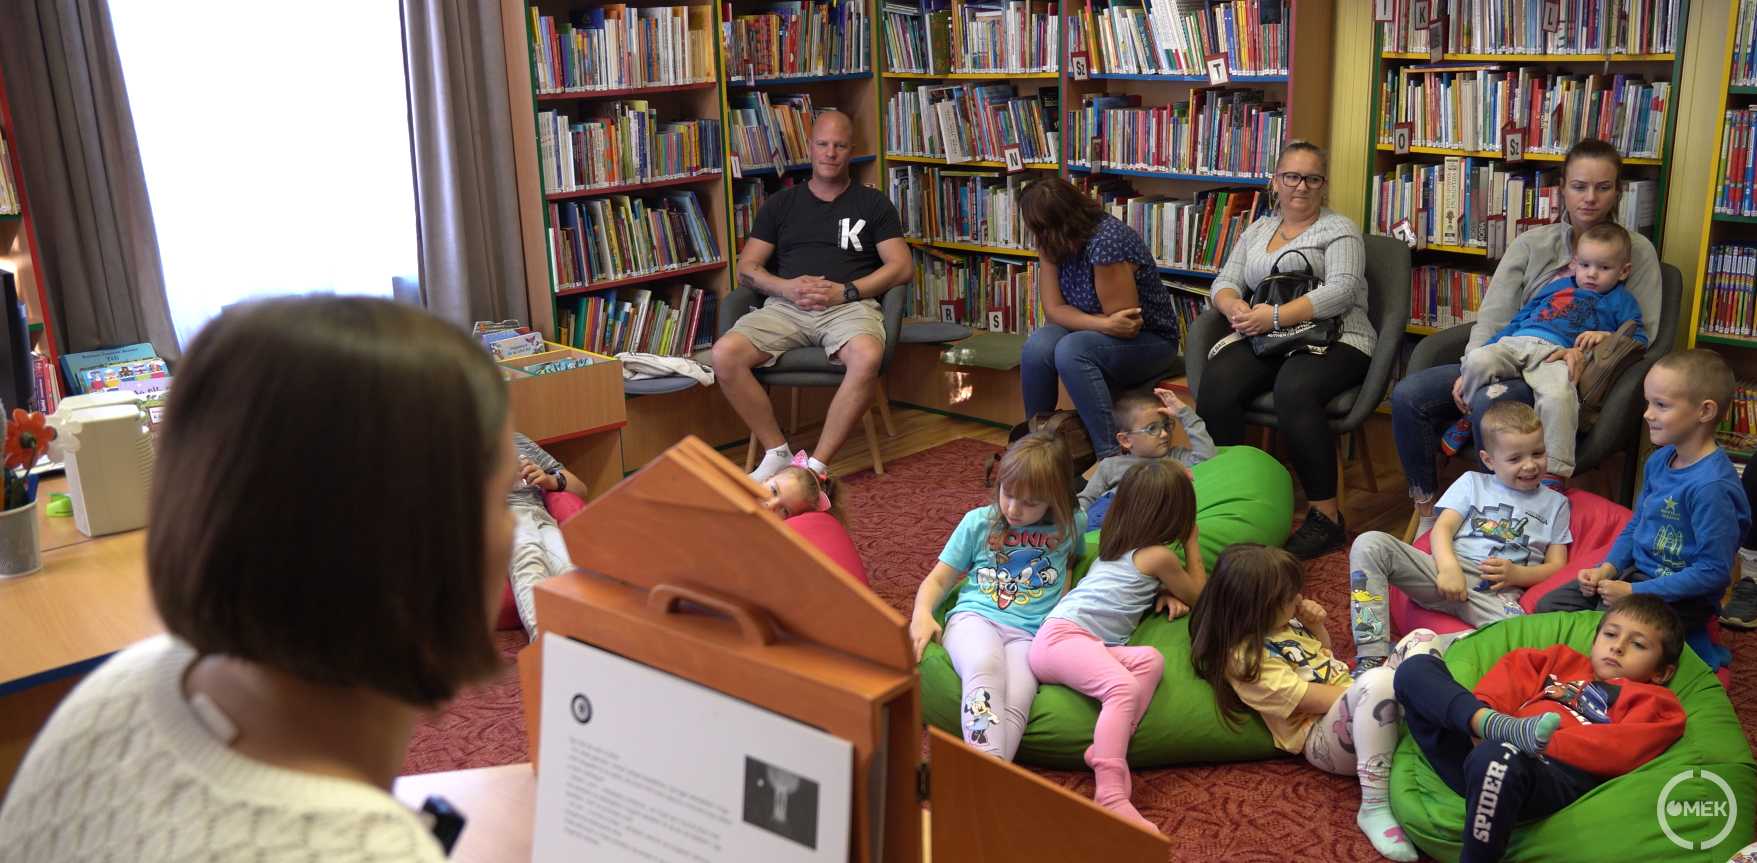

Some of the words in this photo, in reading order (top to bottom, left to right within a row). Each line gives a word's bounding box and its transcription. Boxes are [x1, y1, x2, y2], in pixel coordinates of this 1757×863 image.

[1419, 6, 1426, 23] K
[1547, 7, 1553, 25] L
[1076, 61, 1086, 75] Sz
[1212, 63, 1221, 80] T
[1398, 133, 1405, 149] O
[1509, 138, 1519, 156] Sz
[1008, 152, 1018, 167] N
[841, 217, 866, 251] K
[945, 308, 953, 320] R
[993, 314, 1000, 328] S
